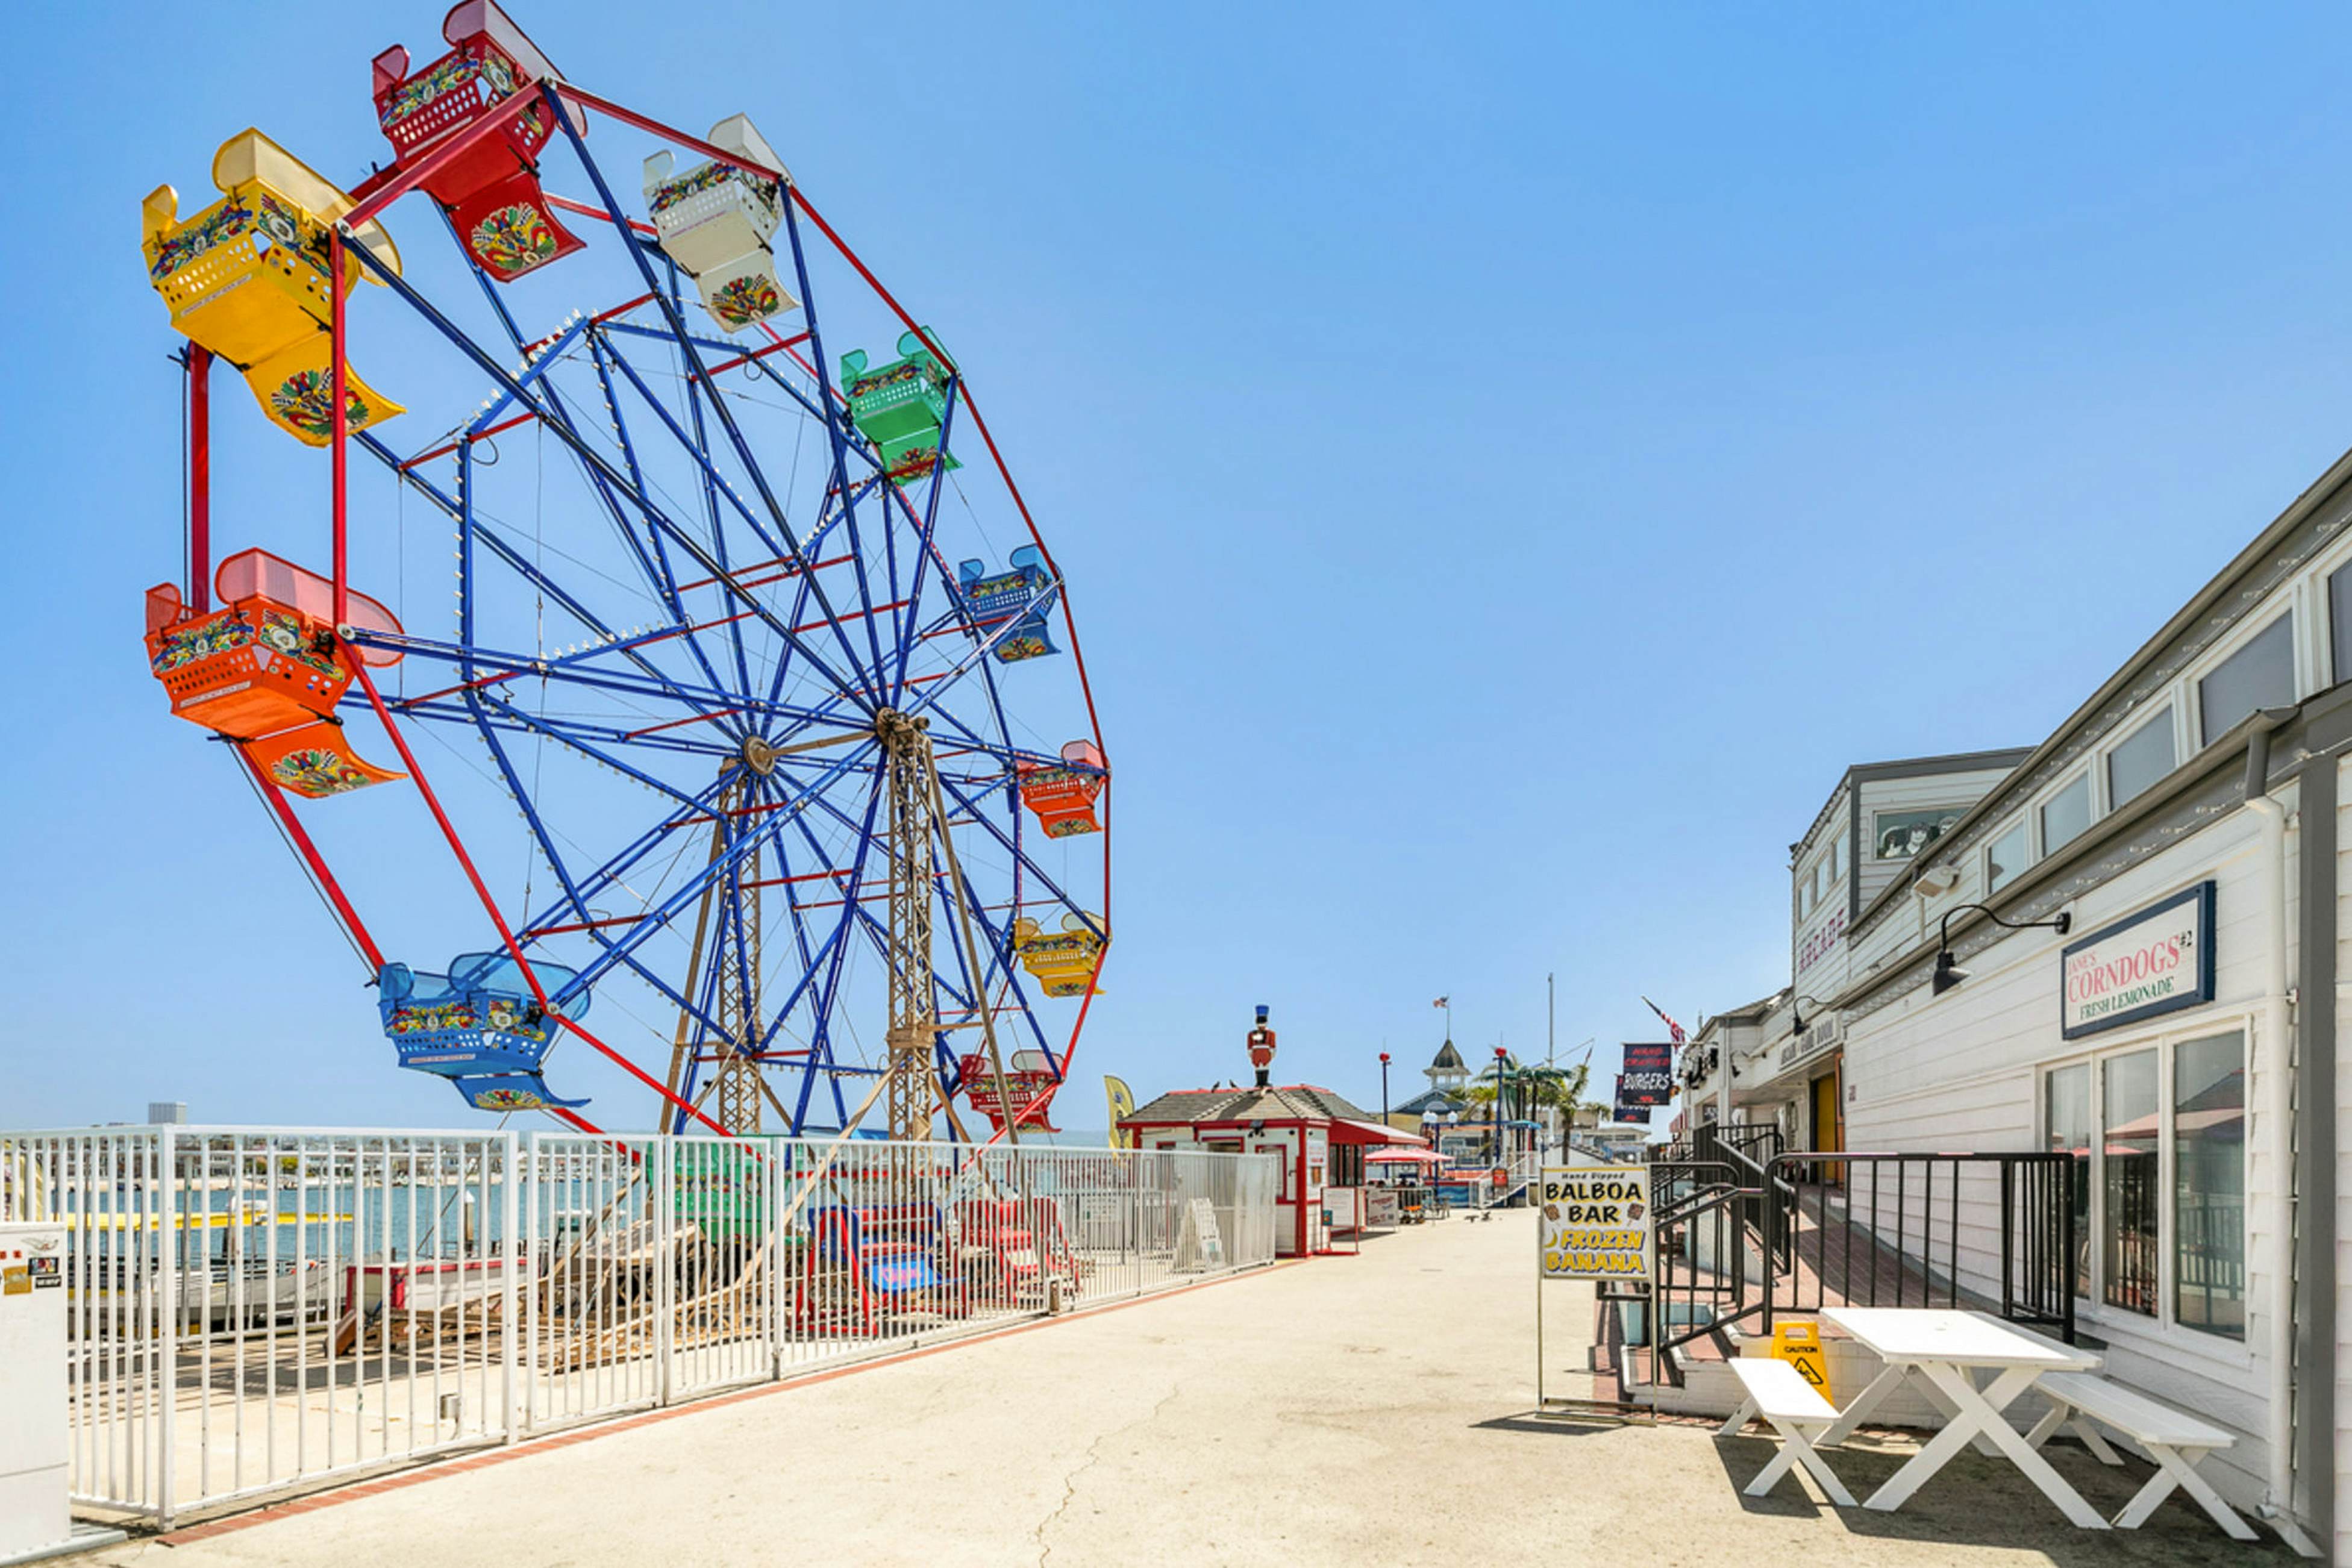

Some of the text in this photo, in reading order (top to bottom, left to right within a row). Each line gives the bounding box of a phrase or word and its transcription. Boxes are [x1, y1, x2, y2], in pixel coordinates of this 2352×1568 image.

[2068, 935, 2180, 1003] CORNDOGS
[2080, 976, 2175, 1020] FRESH LEMONADE
[1623, 1072, 1669, 1090] BURGERS
[1545, 1182, 1644, 1202] BALBOA
[1569, 1205, 1621, 1225] BAR
[1561, 1229, 1646, 1250] FROZEN
[1545, 1252, 1646, 1273] BANANA
